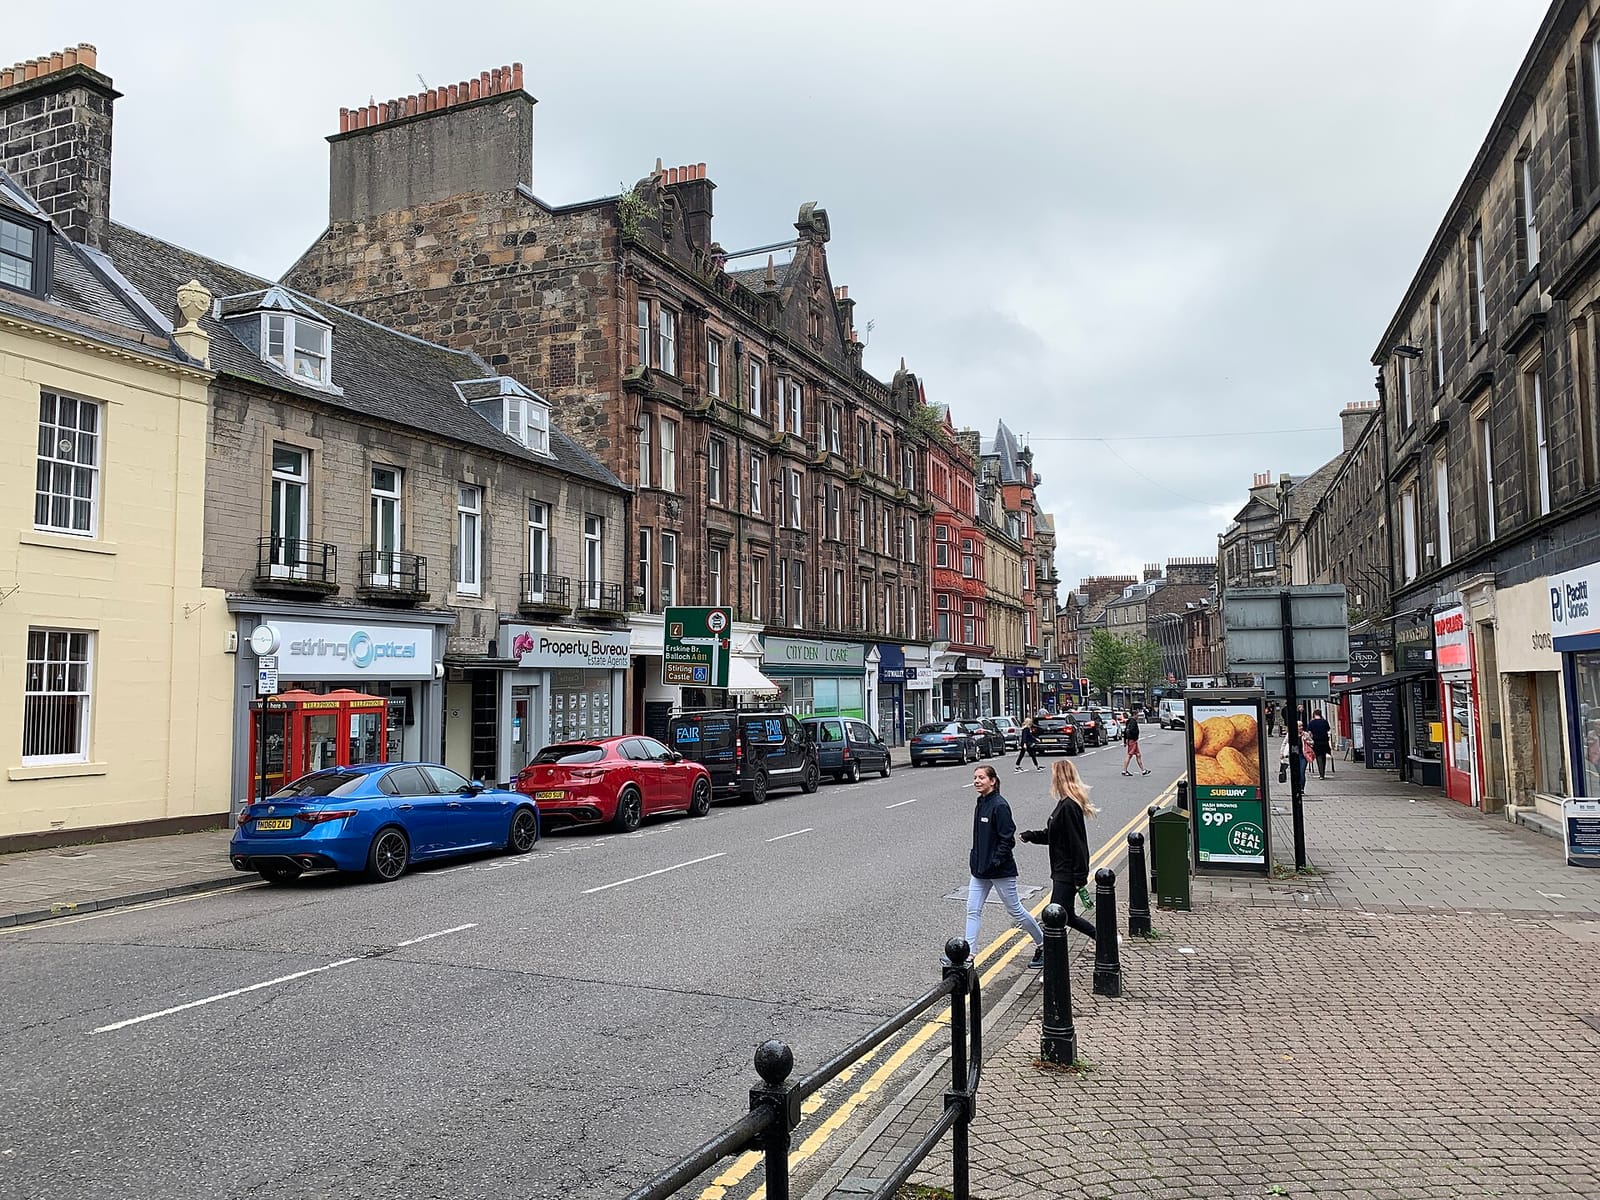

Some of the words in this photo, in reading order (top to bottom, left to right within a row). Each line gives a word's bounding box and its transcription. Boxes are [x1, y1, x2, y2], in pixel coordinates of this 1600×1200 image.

[1566, 580, 1588, 608] Pacitti
[1568, 600, 1589, 619] Jones
[290, 638, 348, 661] stirling
[540, 638, 588, 657] Property
[591, 640, 628, 656] Bureau
[665, 645, 690, 653] Erskine
[786, 645, 800, 660] CITY
[830, 648, 848, 662] CARE
[588, 655, 606, 666] Estate
[607, 656, 628, 667] Agents
[667, 664, 693, 674] Stirling
[677, 727, 699, 738] FAIR
[765, 720, 782, 735] FAIR
[1202, 812, 1233, 826] 99P
[1233, 838, 1260, 850] DEAL
[1235, 831, 1261, 843] REAL
